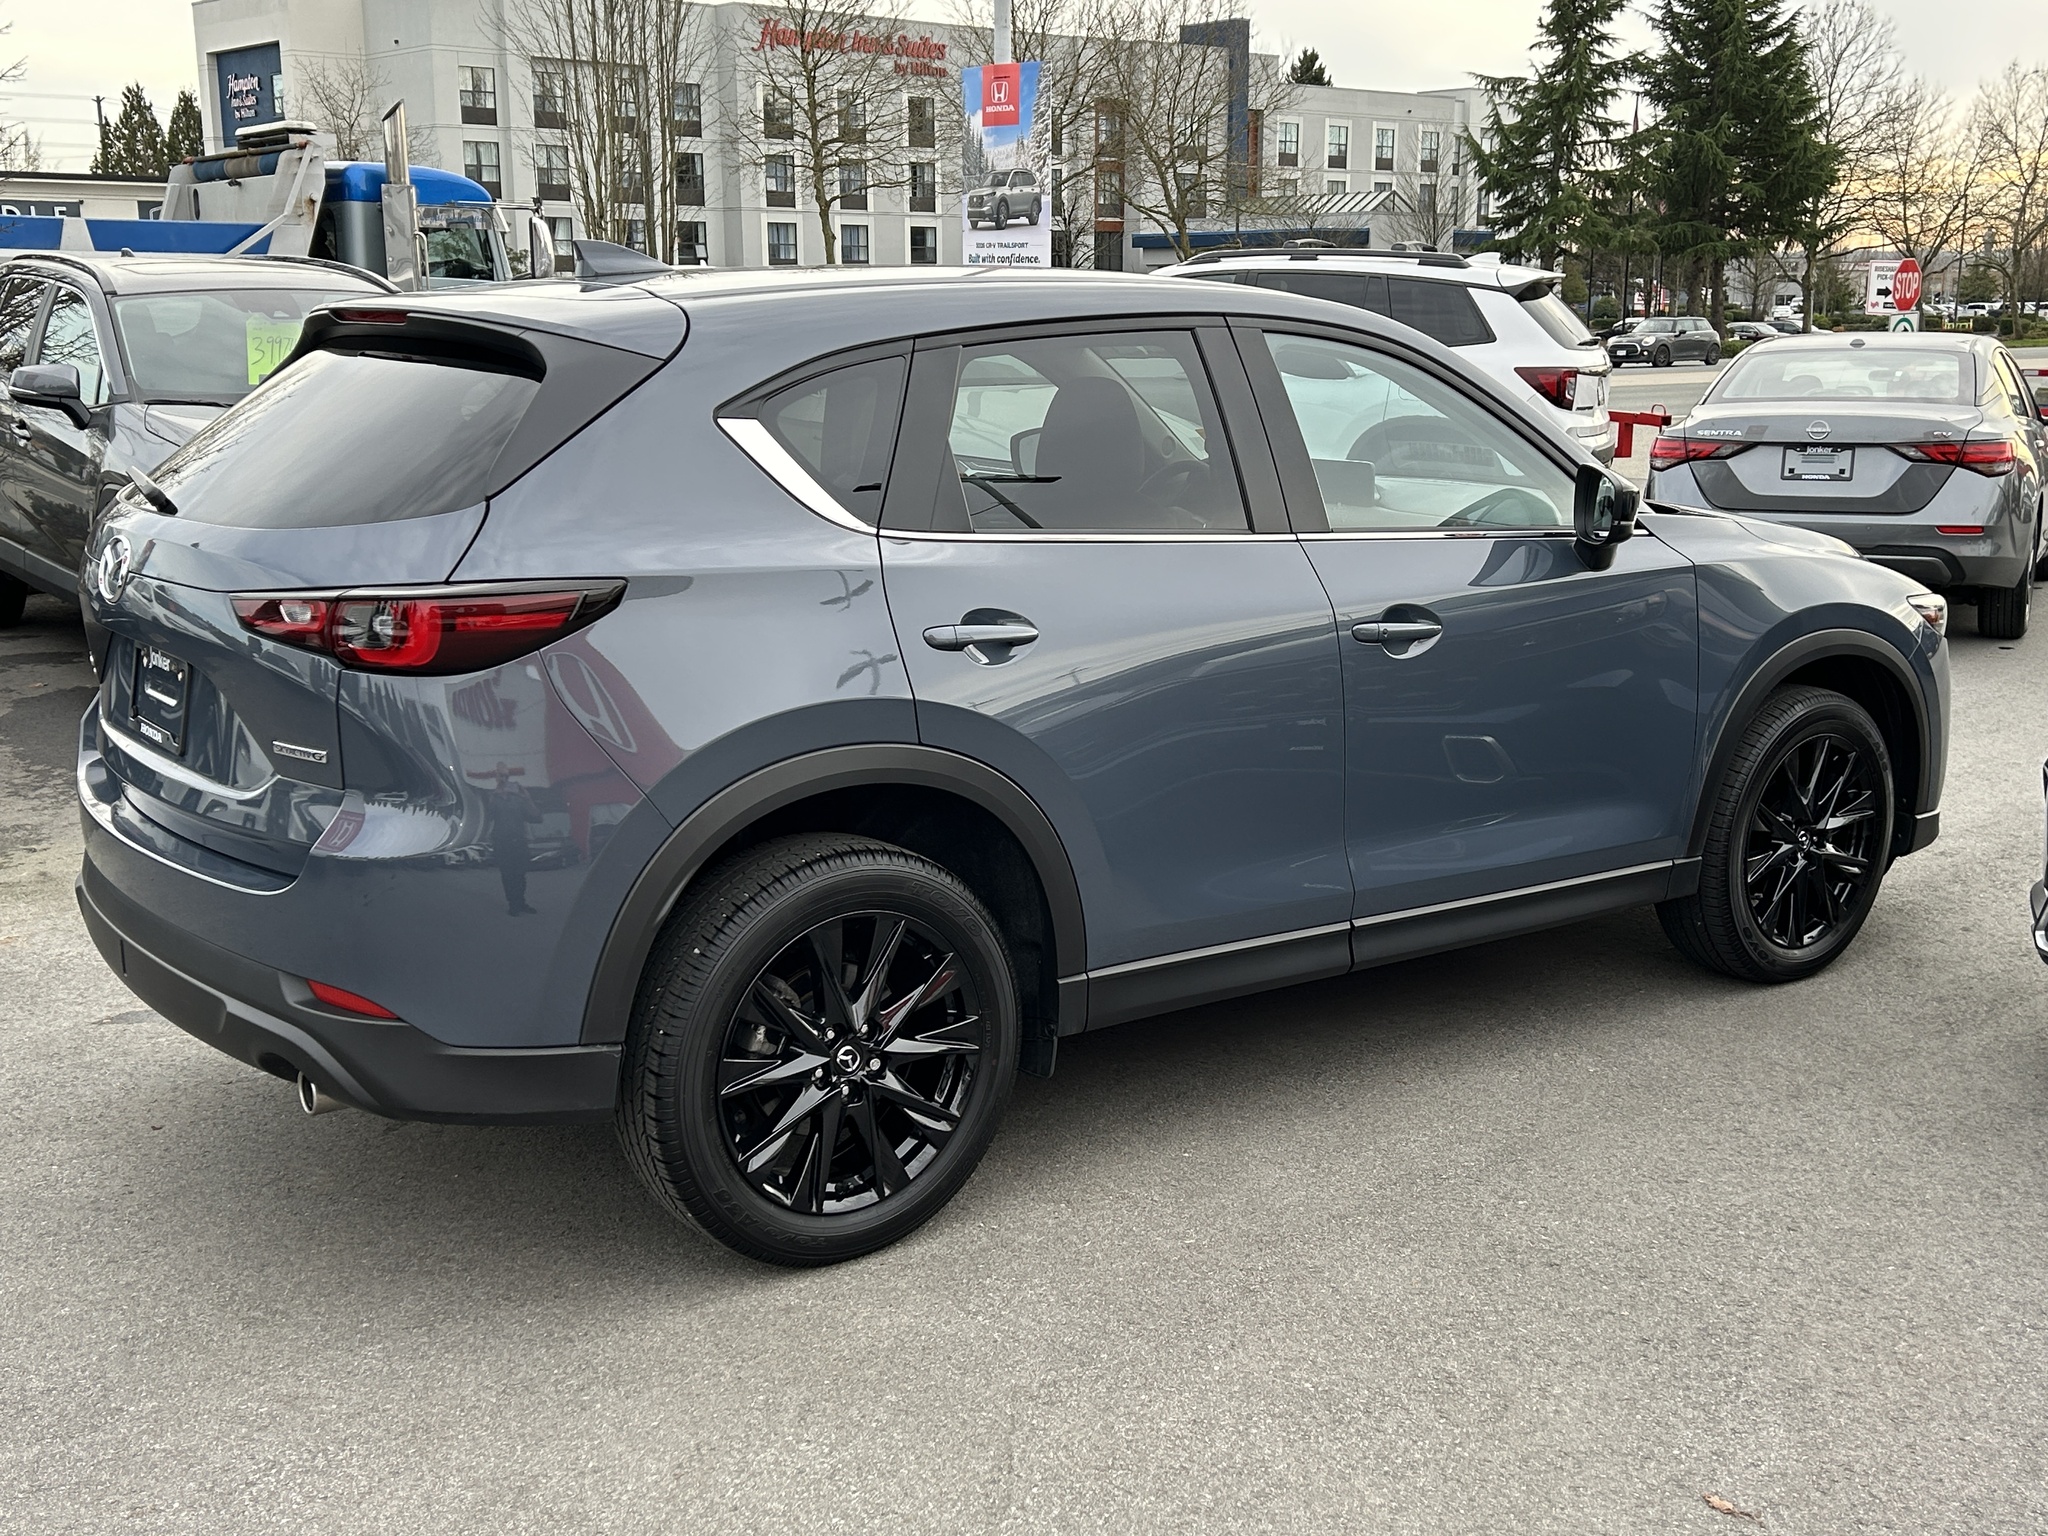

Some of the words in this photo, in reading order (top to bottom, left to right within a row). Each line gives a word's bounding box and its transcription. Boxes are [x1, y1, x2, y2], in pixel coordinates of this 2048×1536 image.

[895, 34, 948, 60] Suites
[894, 60, 908, 77] by
[910, 61, 949, 77] Hilton
[226, 73, 260, 98] Hampton
[985, 104, 1015, 113] HONDA
[968, 253, 981, 264] Built
[981, 252, 996, 264] with
[996, 252, 1041, 267] confidence.
[1894, 271, 1919, 300] STOP
[1696, 429, 1743, 437] SENTRA
[1805, 445, 1834, 455] jonker
[148, 645, 171, 672] jonker
[140, 722, 163, 744] HONDA
[907, 880, 983, 938] TOYO
